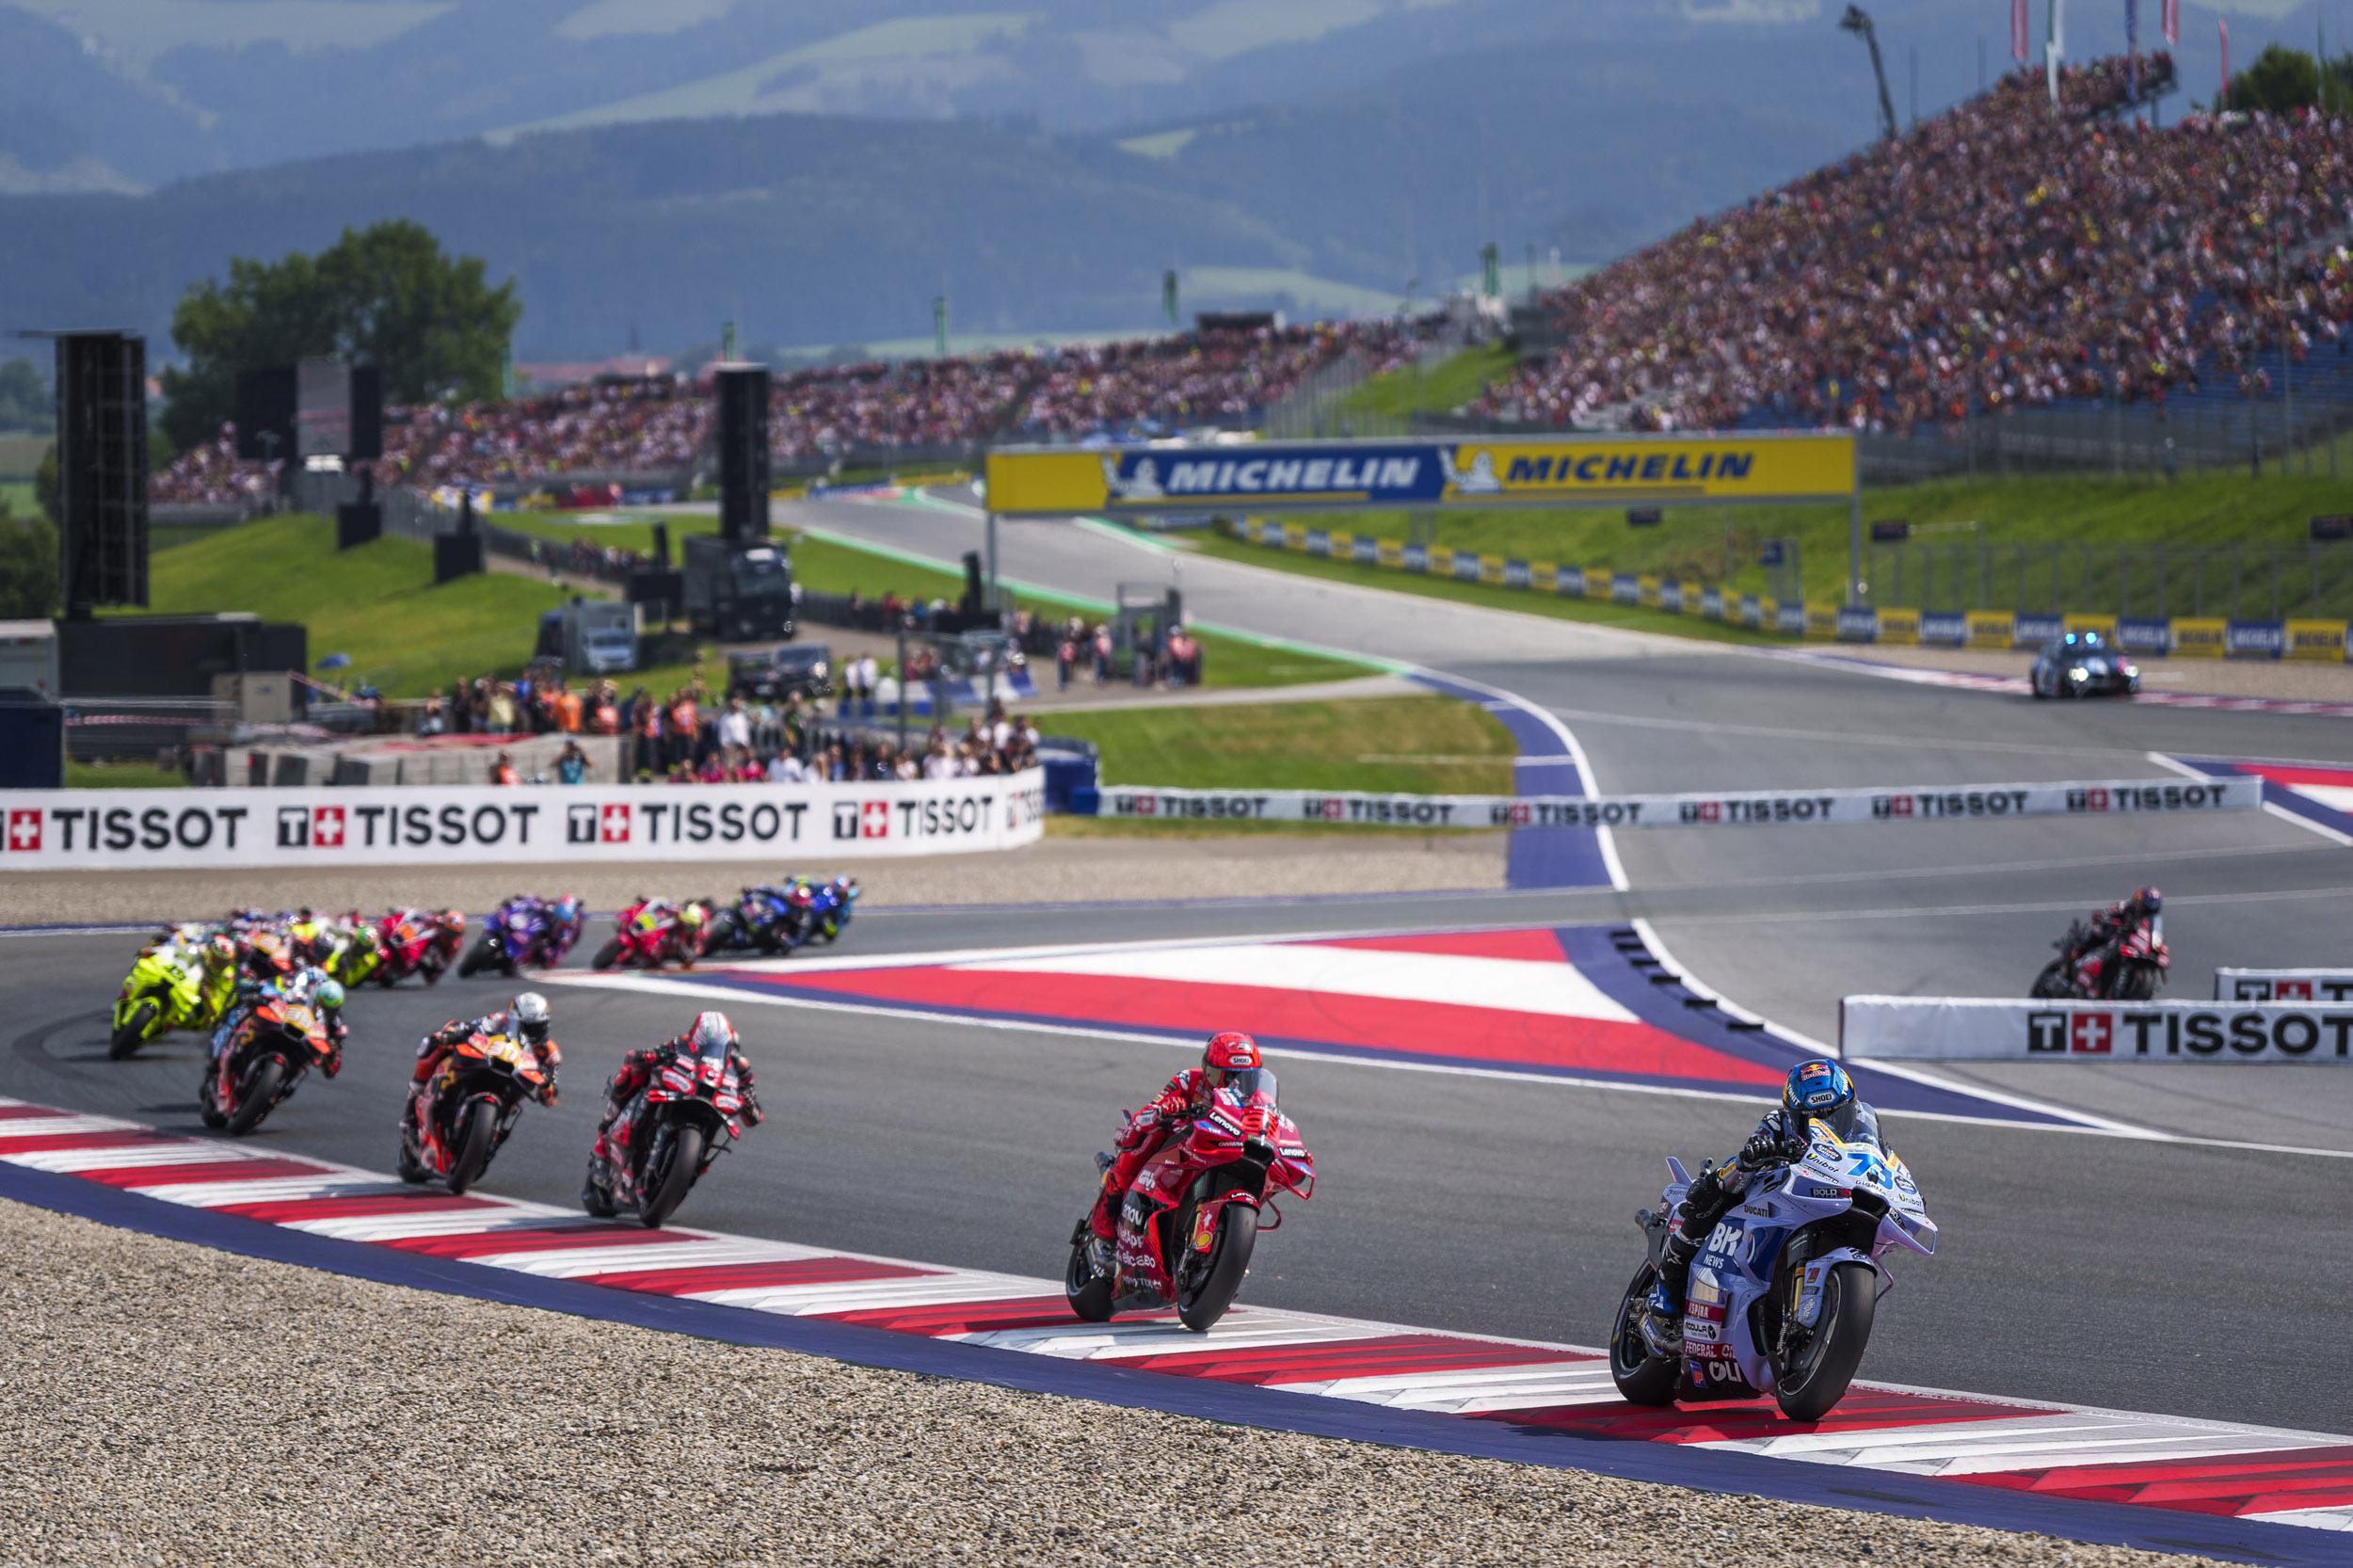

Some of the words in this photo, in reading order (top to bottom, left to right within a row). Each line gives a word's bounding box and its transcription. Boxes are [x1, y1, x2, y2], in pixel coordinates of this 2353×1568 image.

[1168, 457, 1420, 491] MICHELIN
[1508, 452, 1754, 483] MICHELIN
[1159, 796, 1267, 819] TISSOT
[1918, 792, 2028, 817] TISSOT
[2113, 785, 2227, 810] TISSOT
[641, 803, 808, 841] TISSOT
[898, 796, 993, 837] TISSOT
[1345, 799, 1453, 824] TISSOT
[1534, 802, 1642, 825] TISSOT
[1725, 798, 1834, 823] TISSOT
[51, 807, 248, 851] TISSOT
[355, 805, 540, 846] TISSOT
[2123, 1013, 2353, 1055] TISSOT
[1801, 1072, 1817, 1081] Red
[1811, 1093, 1833, 1104] SHOEI
[1209, 1112, 1241, 1136] Lenovo
[1806, 1153, 1839, 1173] Unibat
[1744, 1205, 1768, 1218] DUCATI
[1899, 1193, 1922, 1207] Unibat
[1704, 1254, 1724, 1269] NEWS
[1688, 1301, 1708, 1318] ASPIRA
[1686, 1340, 1717, 1358] FEDERAL
